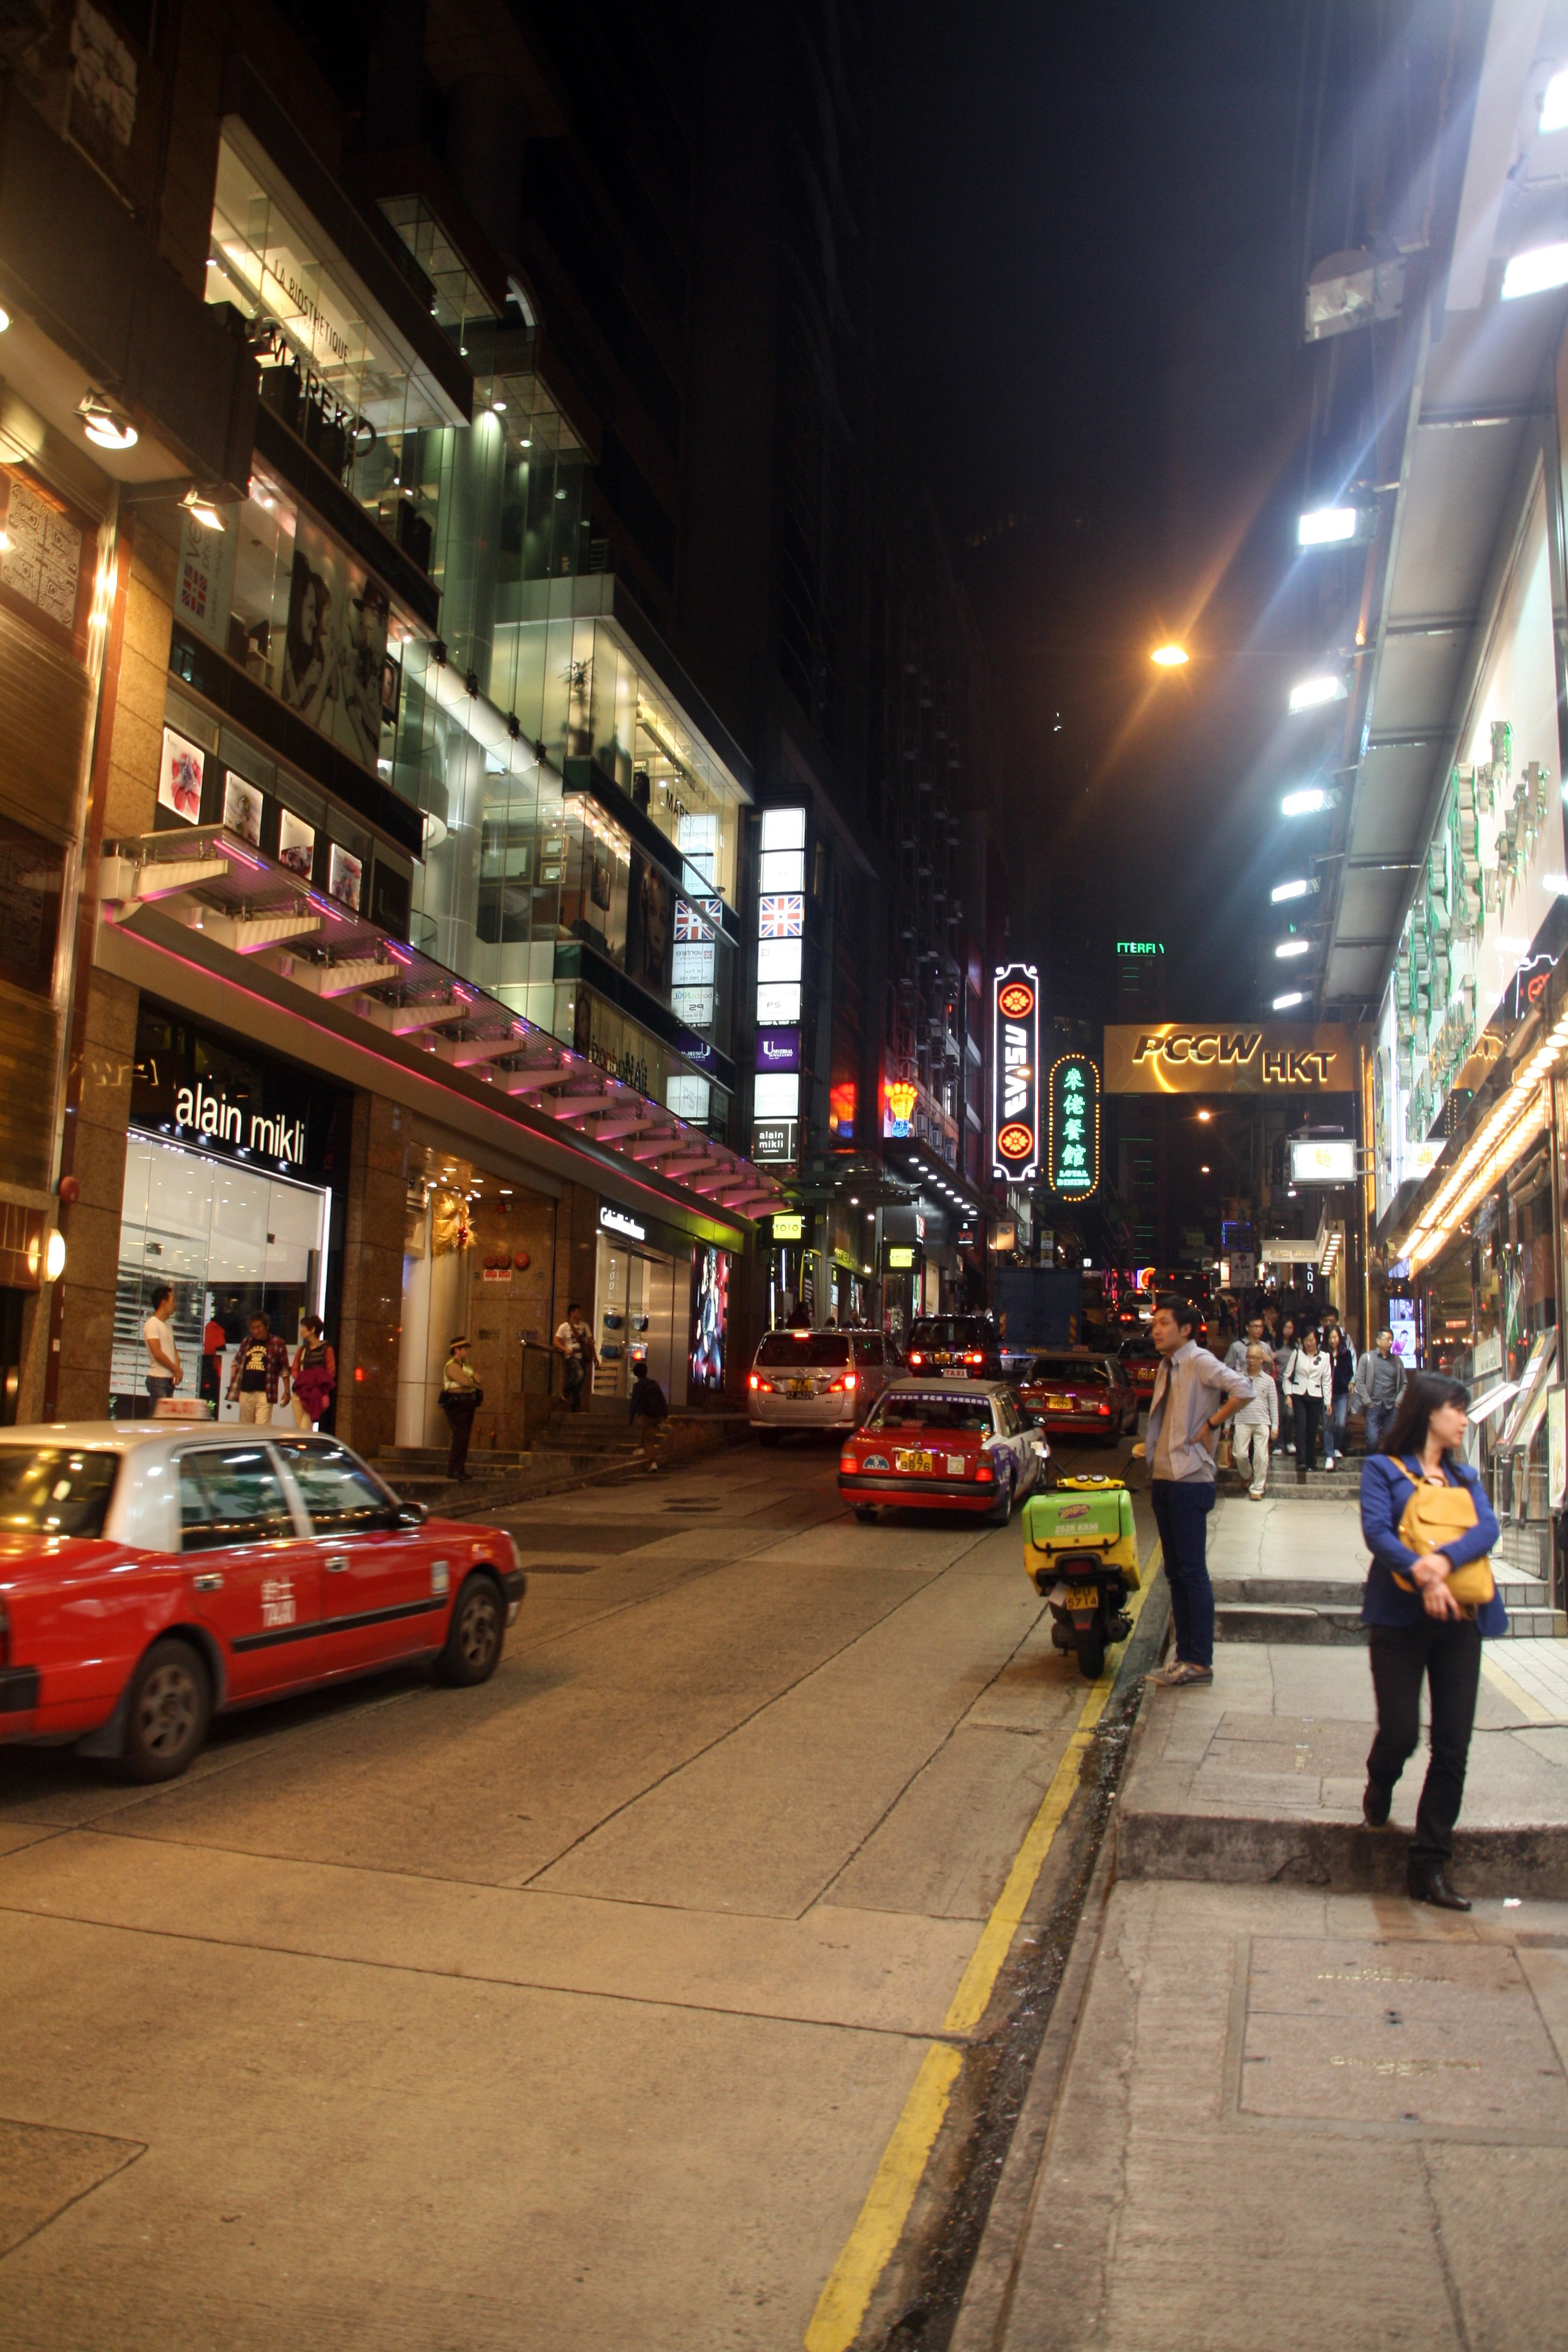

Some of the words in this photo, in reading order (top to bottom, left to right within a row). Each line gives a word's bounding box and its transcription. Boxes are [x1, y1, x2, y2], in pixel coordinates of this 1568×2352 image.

[274, 259, 285, 287] LA
[1133, 1033, 1262, 1065] PCCW
[1262, 1051, 1338, 1082] HKT
[175, 1082, 242, 1144] alain
[250, 1114, 305, 1165] mikli
[759, 1131, 784, 1139] alain
[901, 1461, 931, 1471] 9876
